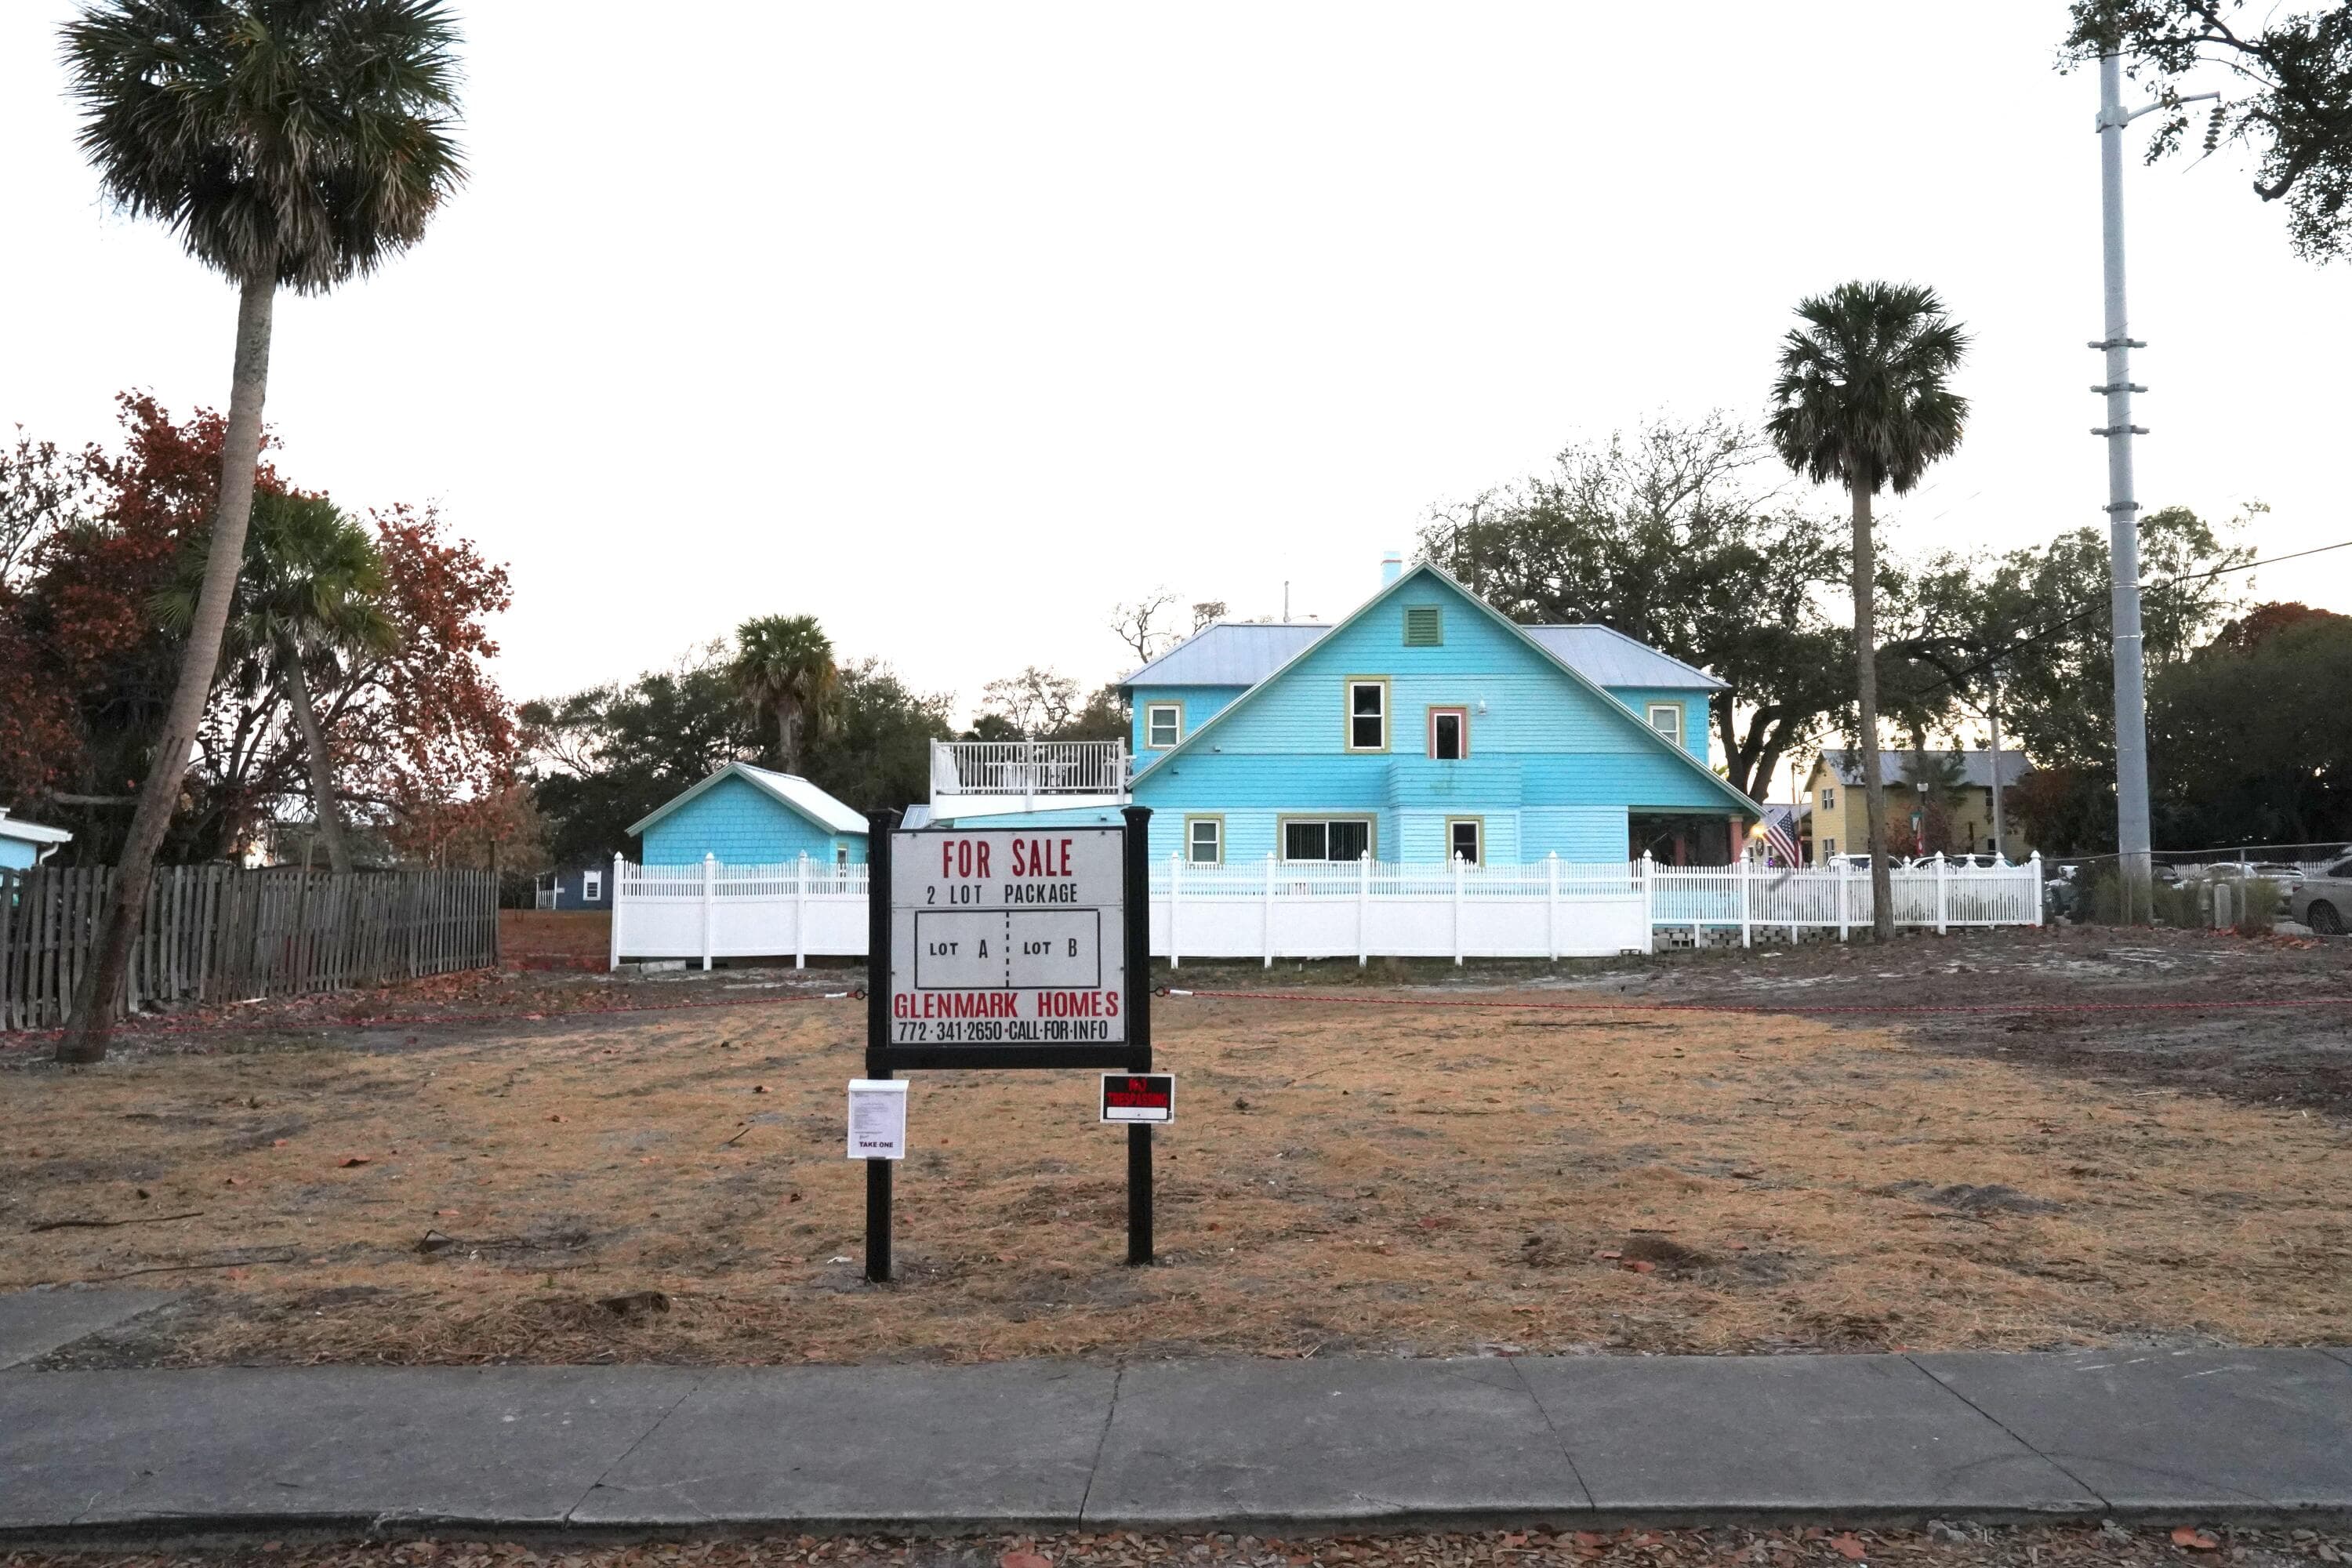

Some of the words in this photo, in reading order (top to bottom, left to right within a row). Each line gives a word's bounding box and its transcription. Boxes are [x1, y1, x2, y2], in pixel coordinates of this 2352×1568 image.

[942, 840, 990, 878] FOR
[1012, 838, 1073, 877] SALE
[927, 885, 935, 905] 2
[950, 884, 982, 904] LOT
[1004, 883, 1077, 903] PACKAGE
[930, 942, 958, 956] LOT
[978, 938, 988, 959] A
[1024, 941, 1051, 955] LOT
[1068, 938, 1077, 958] B
[894, 992, 1018, 1019] GLENMARK
[1037, 991, 1119, 1018] HOMES
